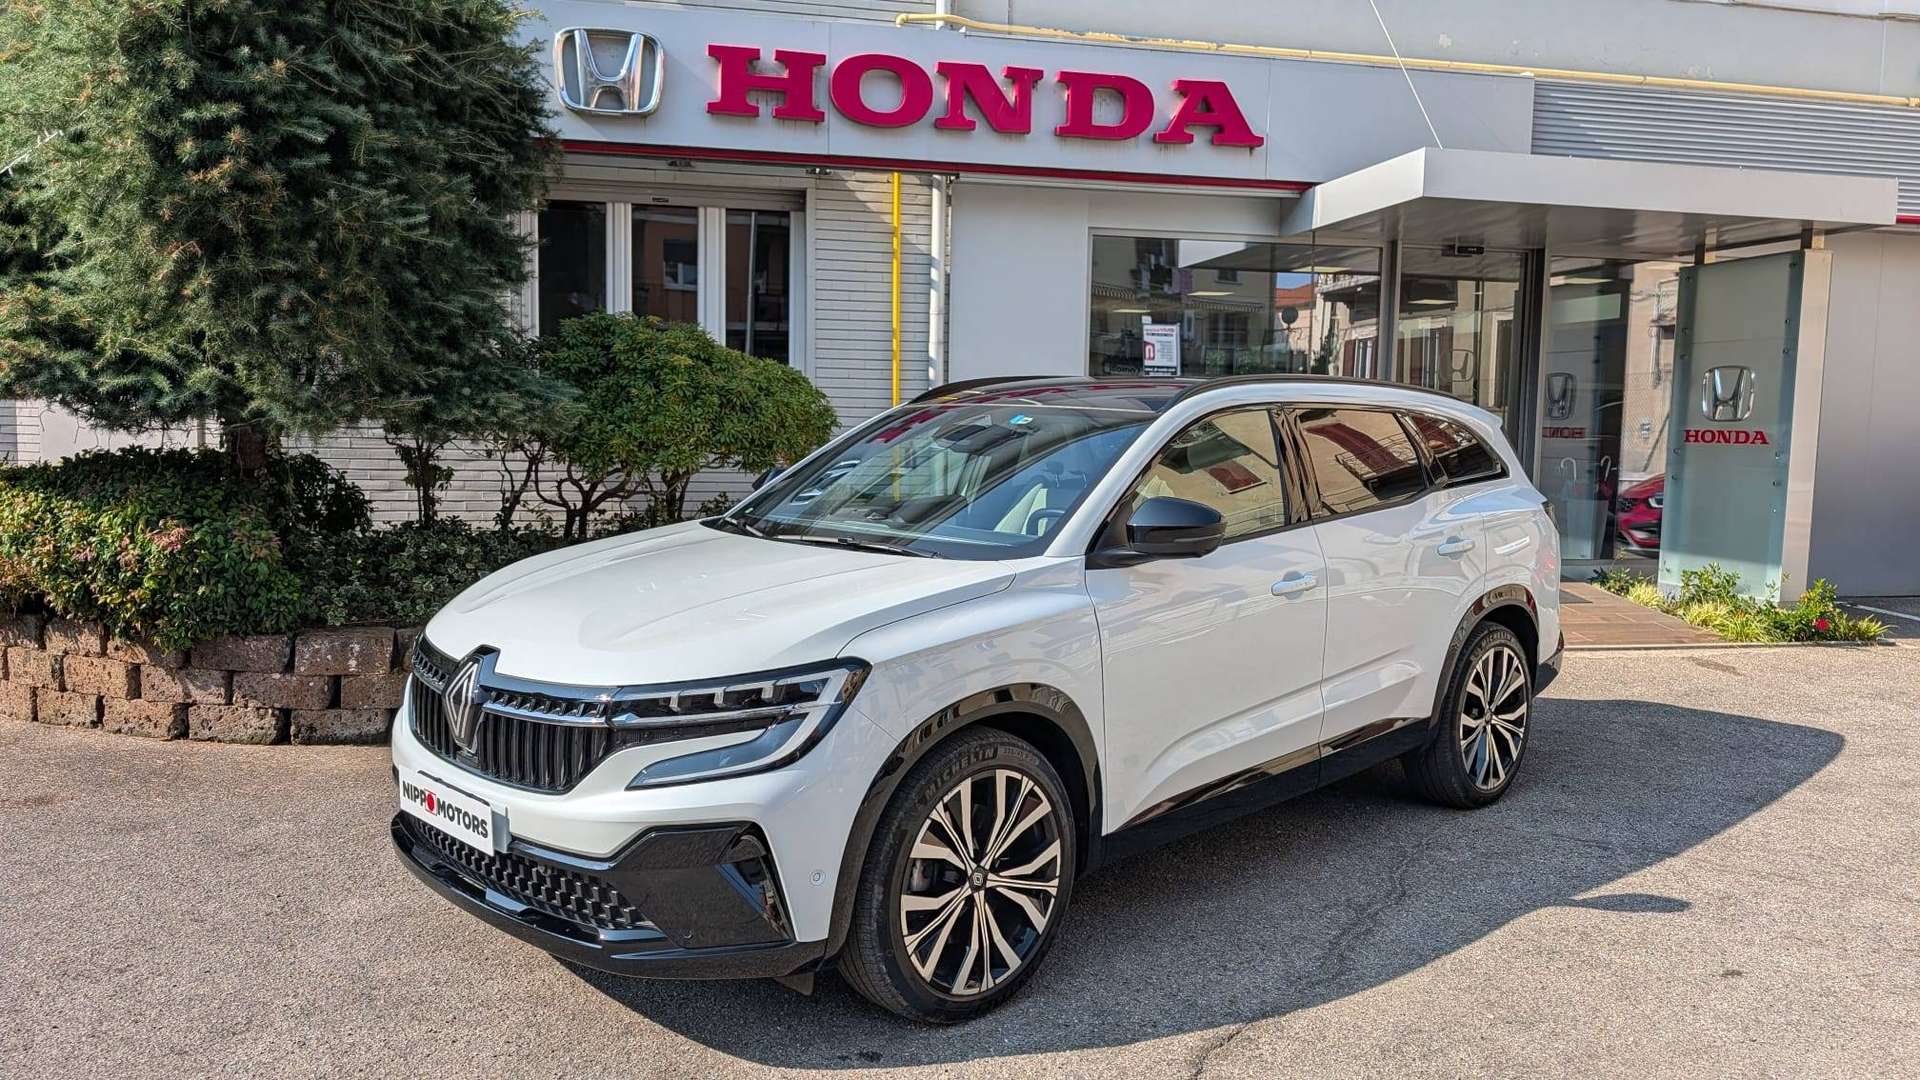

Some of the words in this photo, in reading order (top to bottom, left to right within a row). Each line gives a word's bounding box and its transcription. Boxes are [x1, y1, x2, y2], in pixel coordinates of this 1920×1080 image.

[706, 44, 1264, 148] HONDA
[1684, 429, 1769, 445] HONDA
[926, 747, 996, 798] MICHELIN
